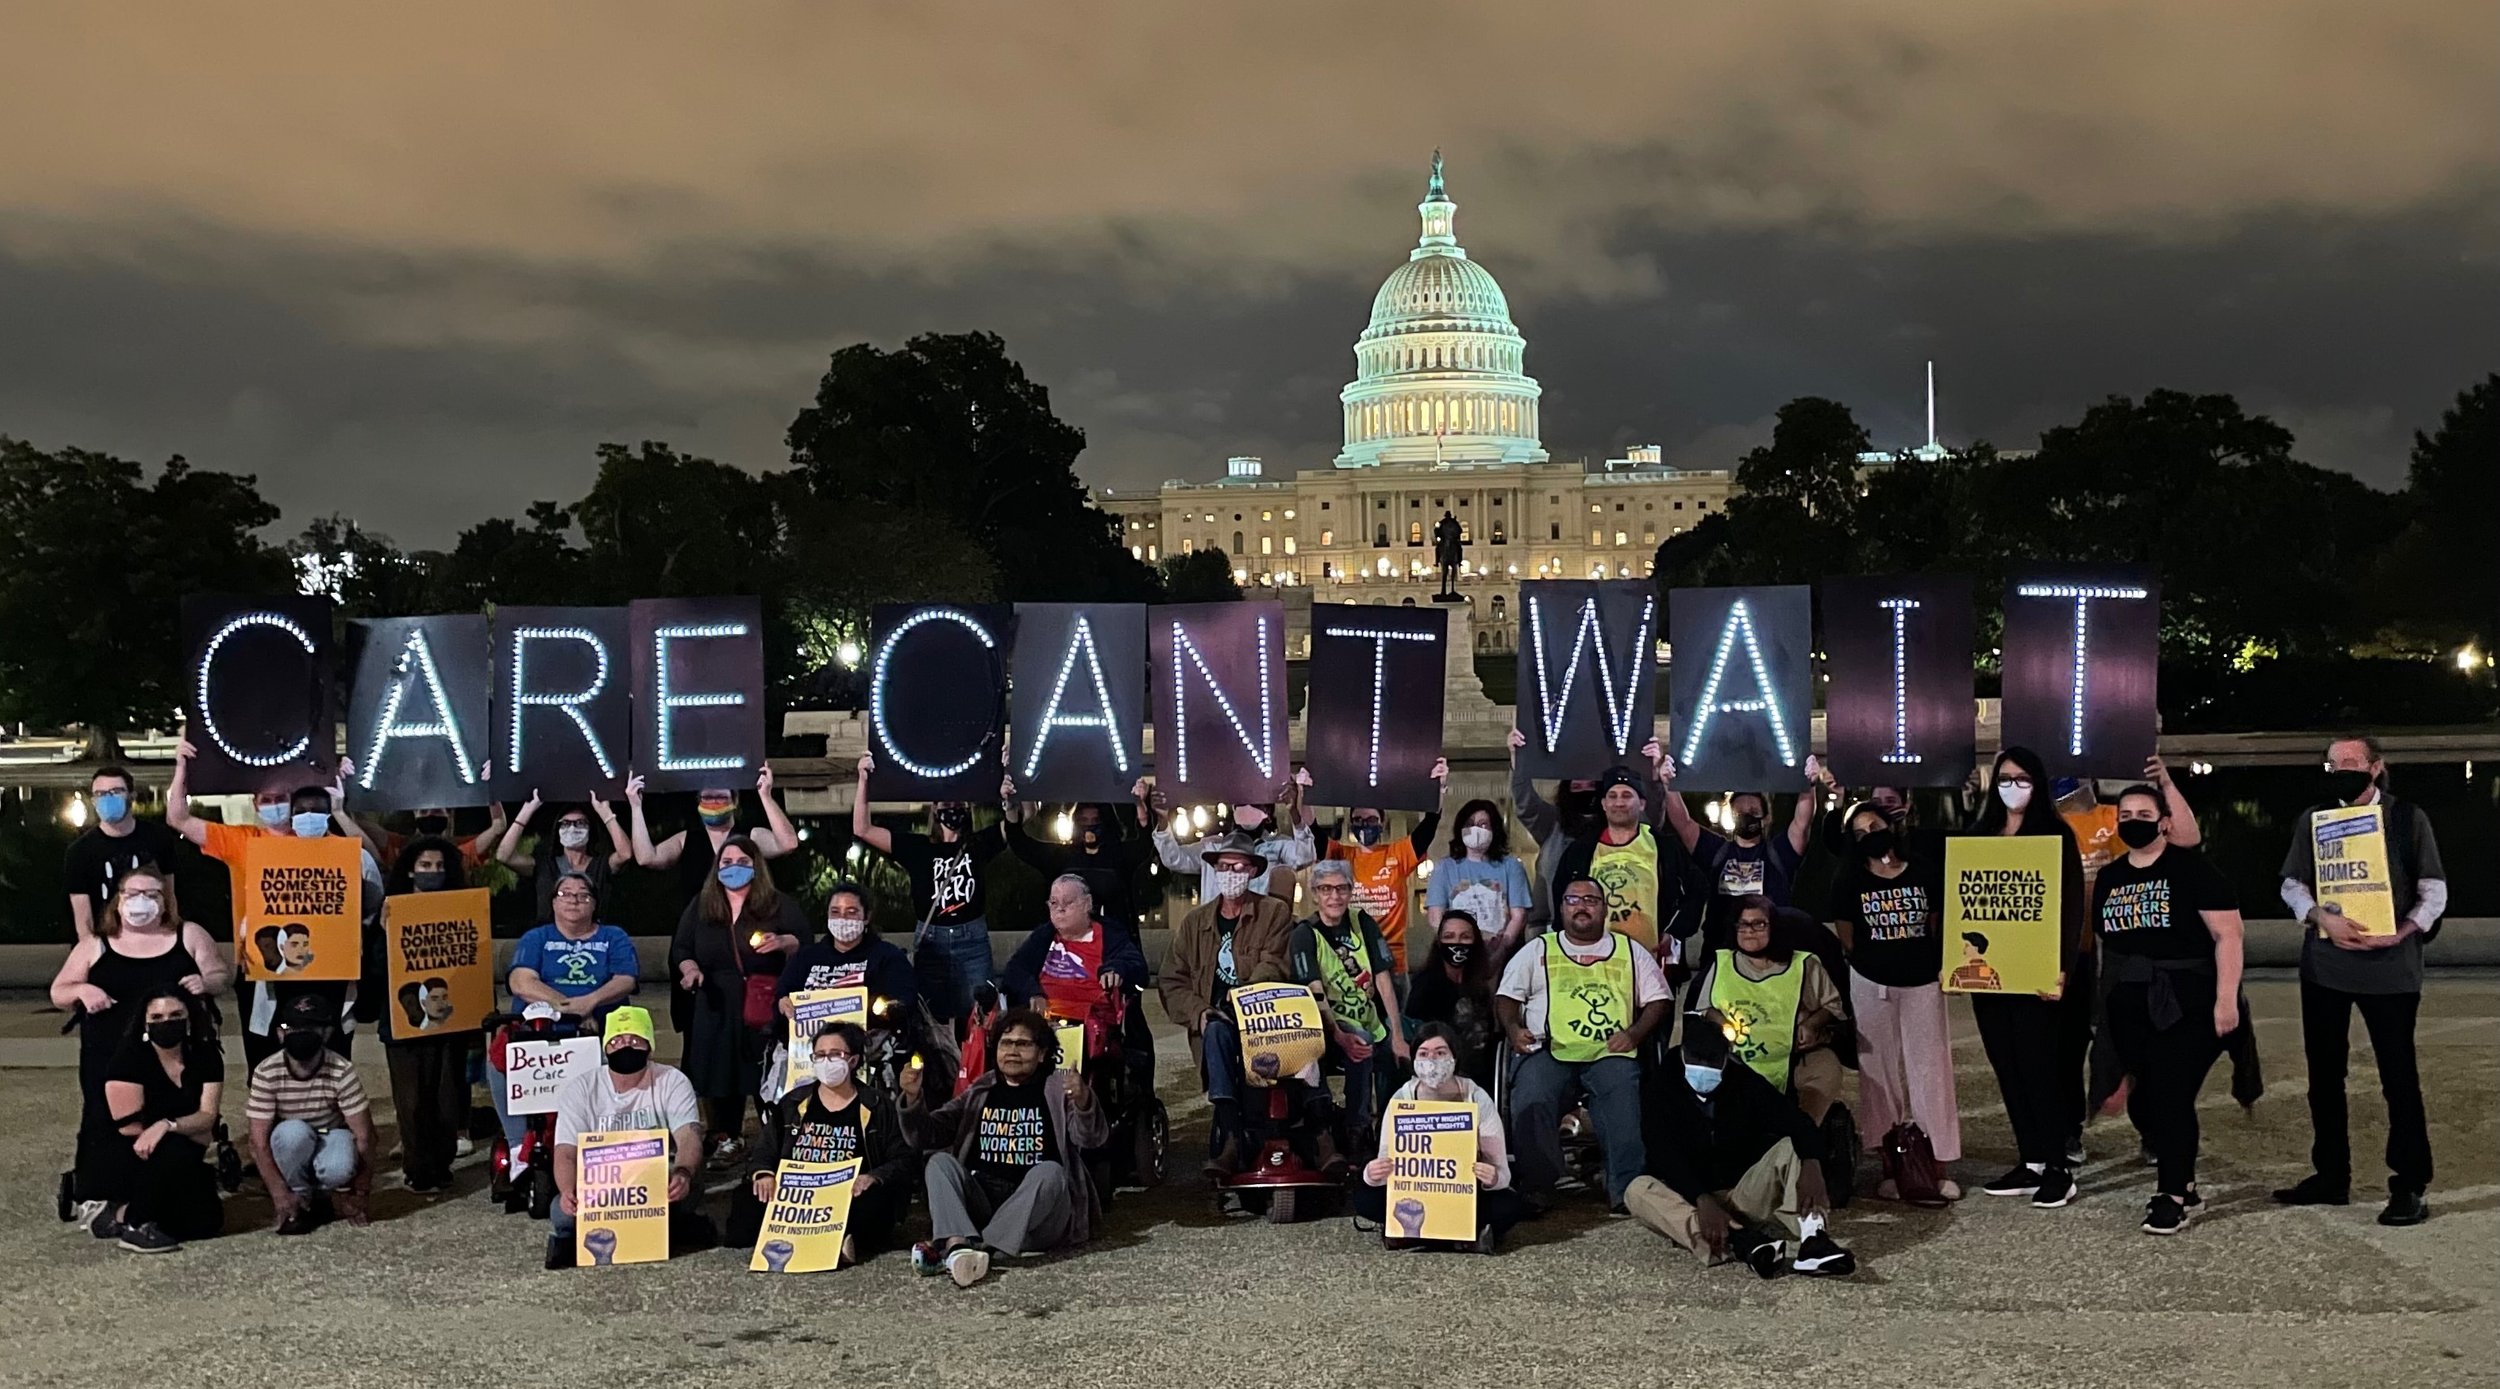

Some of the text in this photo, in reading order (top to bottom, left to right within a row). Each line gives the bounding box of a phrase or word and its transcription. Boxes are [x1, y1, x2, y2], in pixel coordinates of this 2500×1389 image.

[197, 584, 2148, 791] CARE CANT WAIT
[954, 853, 972, 877] A
[2319, 861, 2368, 882] HOMES
[263, 868, 345, 880] NATIONAL
[1961, 870, 2045, 882] NATIONAL
[261, 880, 347, 892] DOMESTIC
[1959, 883, 2046, 895] DOMESTIC
[2109, 879, 2170, 898] NATIONAL
[263, 892, 345, 903] WORKERS
[1961, 896, 2043, 908] WORKERS
[2104, 890, 2170, 906] DOMESTIC
[264, 904, 344, 915] ALLIANCE
[1609, 900, 1642, 922] APT
[1961, 908, 2043, 922] ALLIANCE
[2102, 900, 2170, 918] WORKERS
[402, 919, 477, 937] NATIONAL
[2104, 914, 2171, 933] ALLIANCE
[401, 930, 478, 949] DOMESTIC
[403, 942, 478, 961] WORKERS
[405, 953, 477, 973] ALLIANCE
[1241, 1002, 1276, 1017] OUR
[1244, 1012, 1304, 1035] HOMES
[1247, 1035, 1265, 1048] NOT
[510, 1047, 574, 1071] Better
[533, 1068, 566, 1081] Care
[511, 1083, 558, 1100] Better
[982, 1107, 1042, 1122] NATIONAL
[1397, 1116, 1439, 1125] DISABILITY
[803, 1121, 857, 1137] NATIONAL
[980, 1121, 1043, 1136] DOMESTIC
[1415, 1123, 1436, 1131] CIVIL
[796, 1134, 857, 1149] DOMESTIC
[980, 1136, 1043, 1152] WORKERS
[1395, 1134, 1432, 1154] OUR
[584, 1165, 622, 1185] OUR
[1395, 1157, 1456, 1179] HOMES
[783, 1173, 827, 1181] DISABILITY
[1394, 1181, 1474, 1194] NOT INSTITUTIONS
[584, 1186, 648, 1209] HOMES
[776, 1187, 815, 1206] OUR
[583, 1206, 666, 1222] NOT INSTITUTIONS
[771, 1204, 833, 1225] HOMES
[767, 1222, 844, 1235] NOT INSTITUTIONS
